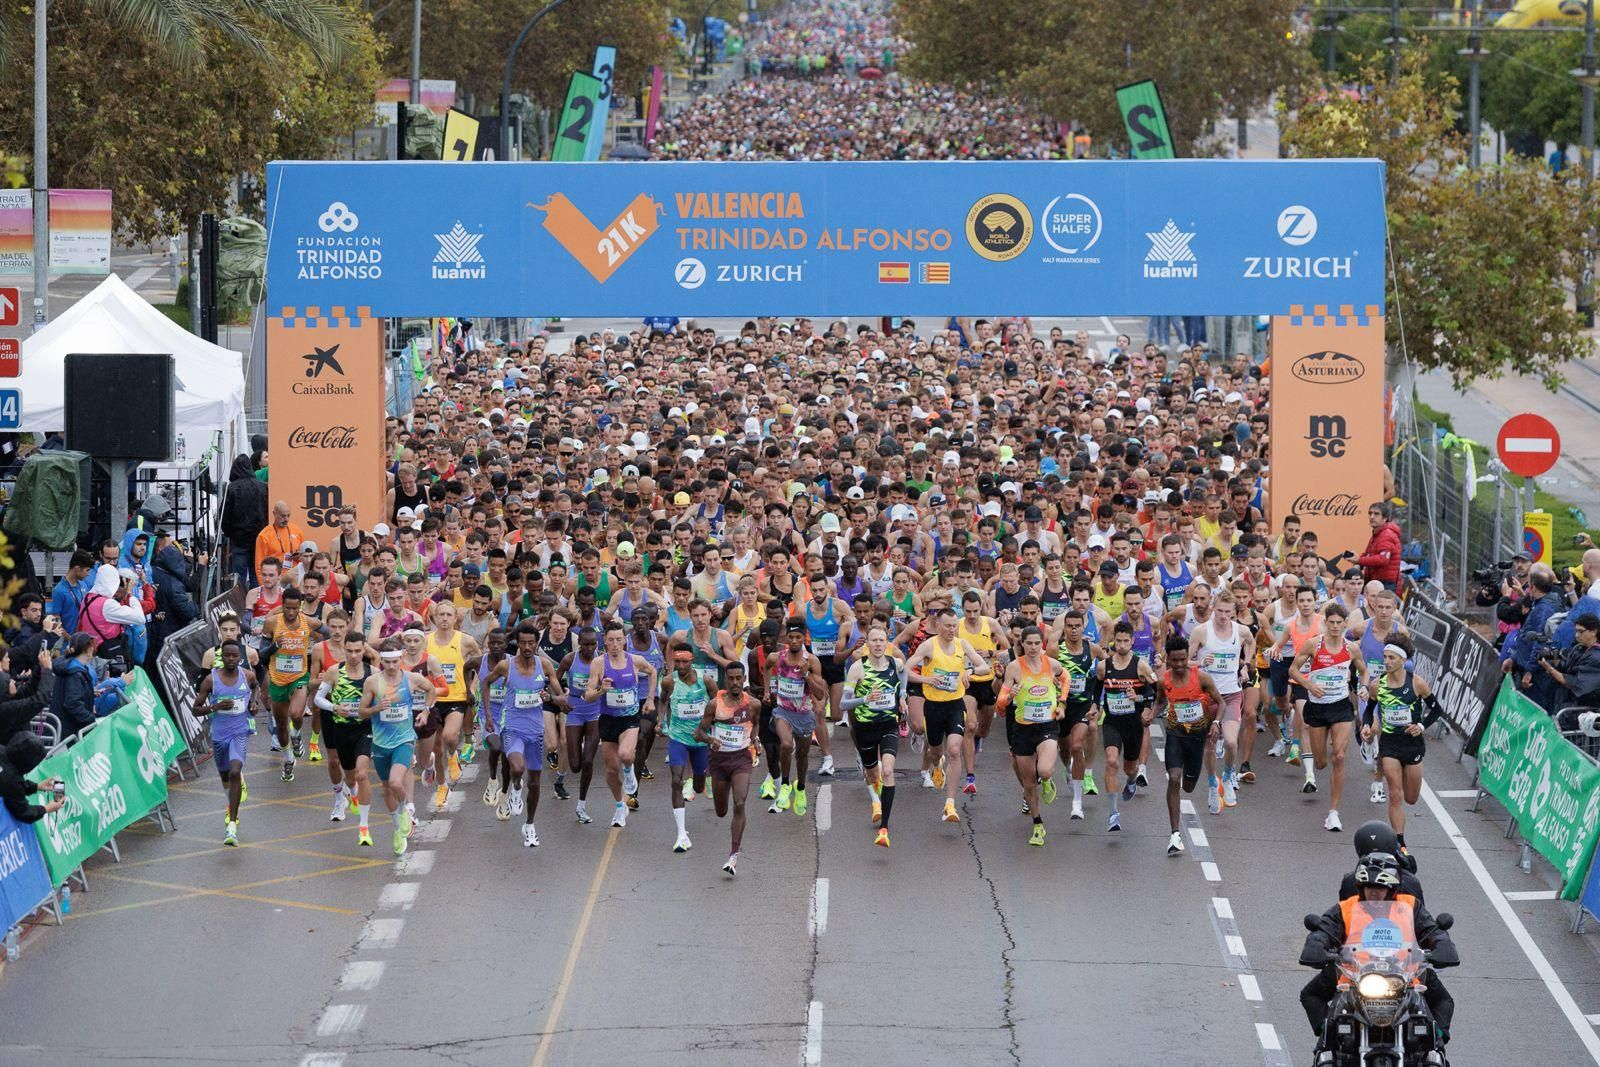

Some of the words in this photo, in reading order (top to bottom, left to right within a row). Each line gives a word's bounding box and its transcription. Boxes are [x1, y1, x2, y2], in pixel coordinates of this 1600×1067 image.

[597, 63, 612, 100] 3
[561, 95, 594, 142] 2
[675, 192, 804, 219] VALENCIA
[1053, 213, 1092, 224] SUPER
[1052, 224, 1091, 234] HALFS
[297, 236, 382, 247] FUNDACIÓN
[597, 210, 647, 268] 21K
[676, 227, 808, 251] TRINIDAD
[816, 228, 952, 252] ALFONSO
[297, 250, 382, 264] TRINIDAD
[297, 265, 382, 280] ALFONSO
[432, 264, 486, 280] luanvi
[717, 265, 802, 282] ZURICH
[1143, 263, 1198, 279] luanvi
[1243, 256, 1352, 279] ZURICH
[1298, 363, 1359, 376] ASTURIANA
[292, 382, 354, 395] CaixaBank
[288, 426, 359, 449] Coca-Cola
[1291, 493, 1361, 517] Coca-Cola
